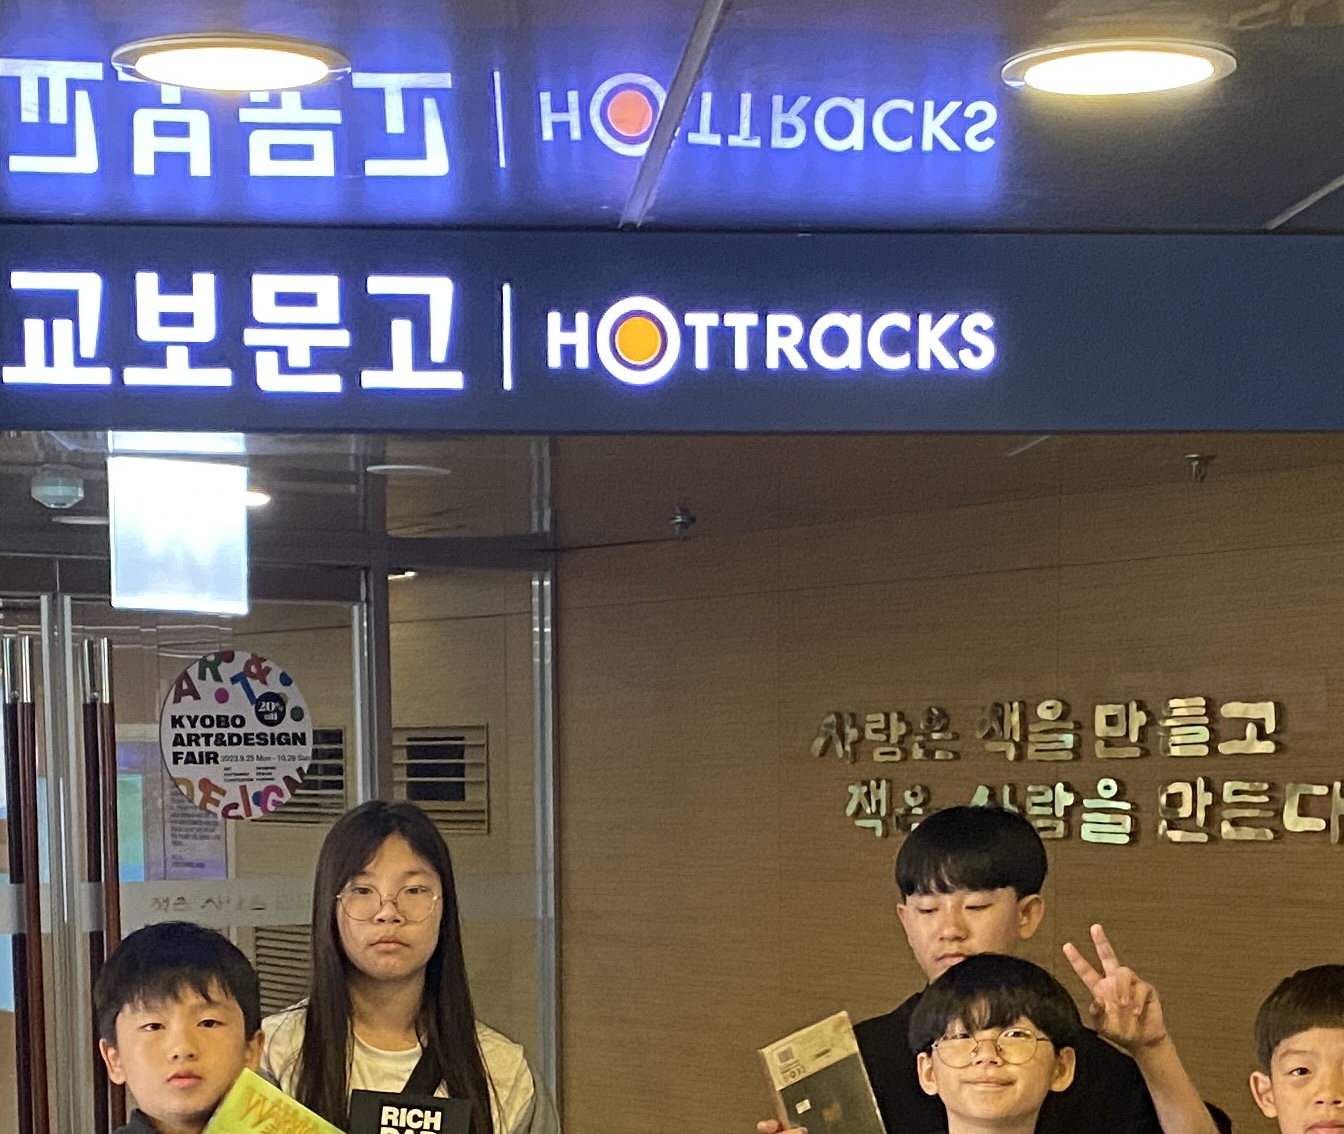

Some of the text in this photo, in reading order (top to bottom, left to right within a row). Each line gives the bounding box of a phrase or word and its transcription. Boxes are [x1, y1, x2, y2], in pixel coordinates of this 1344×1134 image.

[1, 271, 465, 394] 교보문고
[171, 714, 246, 729] KYOBO
[810, 696, 1279, 763] 사람은 책을 만들고
[172, 732, 307, 747] ART&DESIGN
[172, 751, 220, 765] FAIR
[844, 779, 930, 837] 책은
[380, 1105, 442, 1131] RICH
